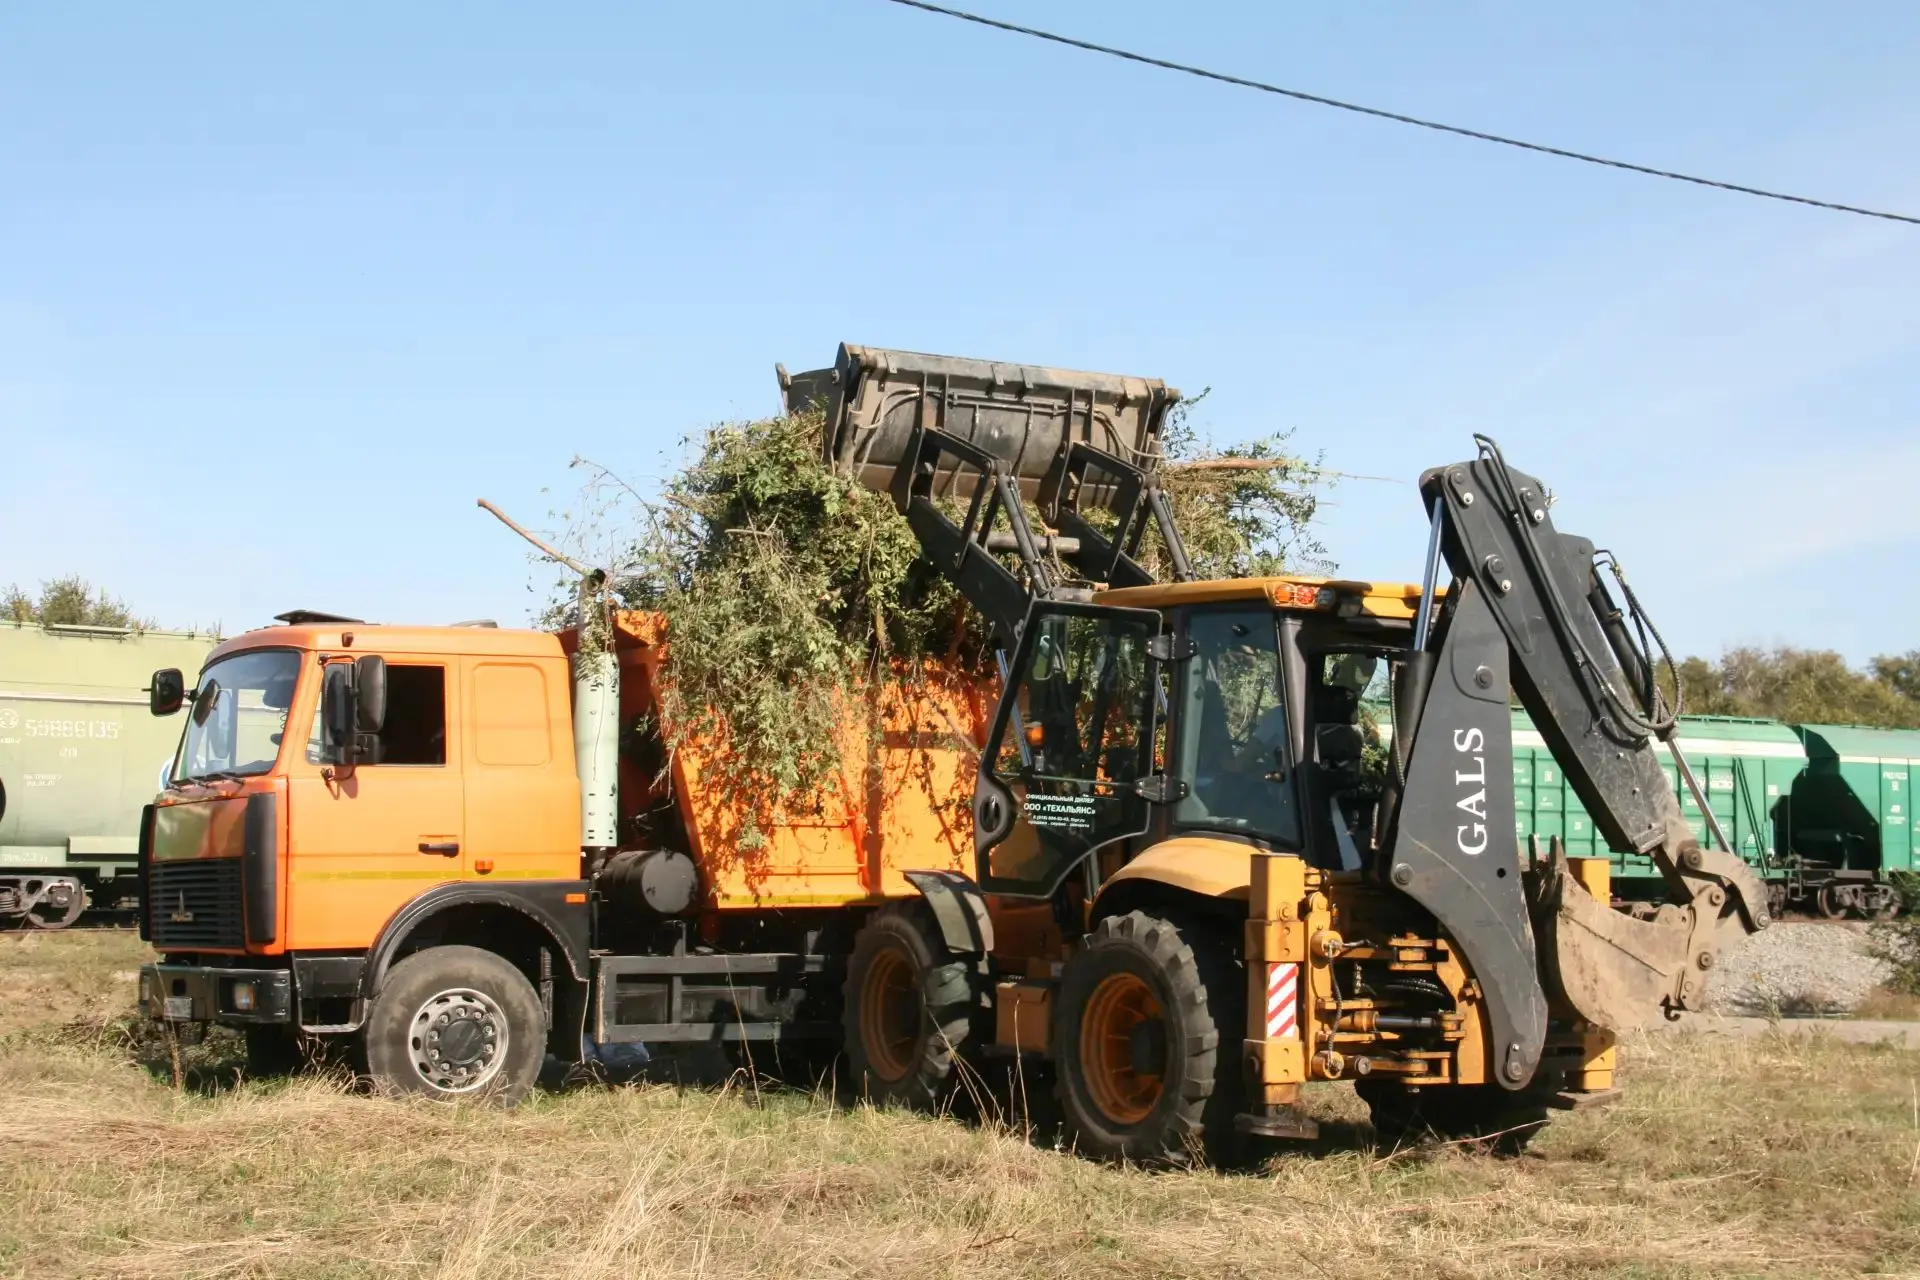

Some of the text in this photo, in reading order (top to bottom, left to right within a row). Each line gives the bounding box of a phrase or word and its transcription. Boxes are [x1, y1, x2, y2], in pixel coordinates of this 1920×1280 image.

[1453, 727, 1488, 855] GALS
[1025, 794, 1073, 802] ОФИЦИАЛЬНЫЙ
[1023, 803, 1096, 815] ООО «ТЕХАЛЬЯНС»
